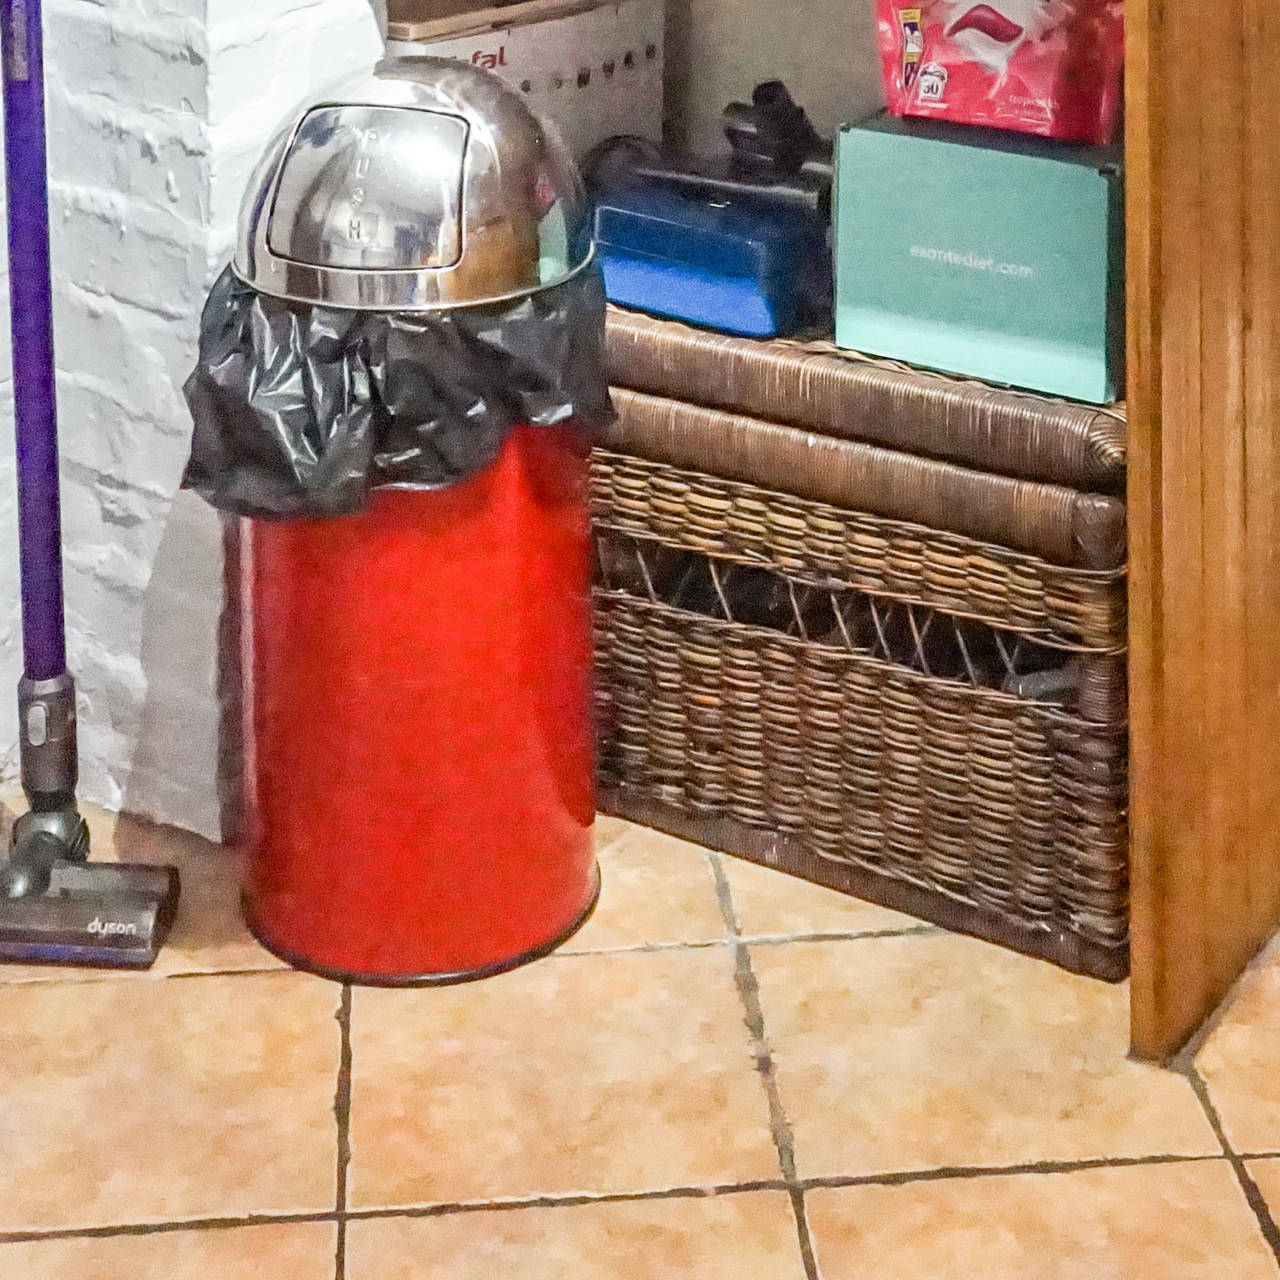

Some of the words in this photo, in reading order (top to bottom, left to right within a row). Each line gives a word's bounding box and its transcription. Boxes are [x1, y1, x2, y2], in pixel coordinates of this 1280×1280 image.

[471, 46, 508, 69] fal
[922, 80, 939, 95] 30
[87, 917, 136, 939] dyson
